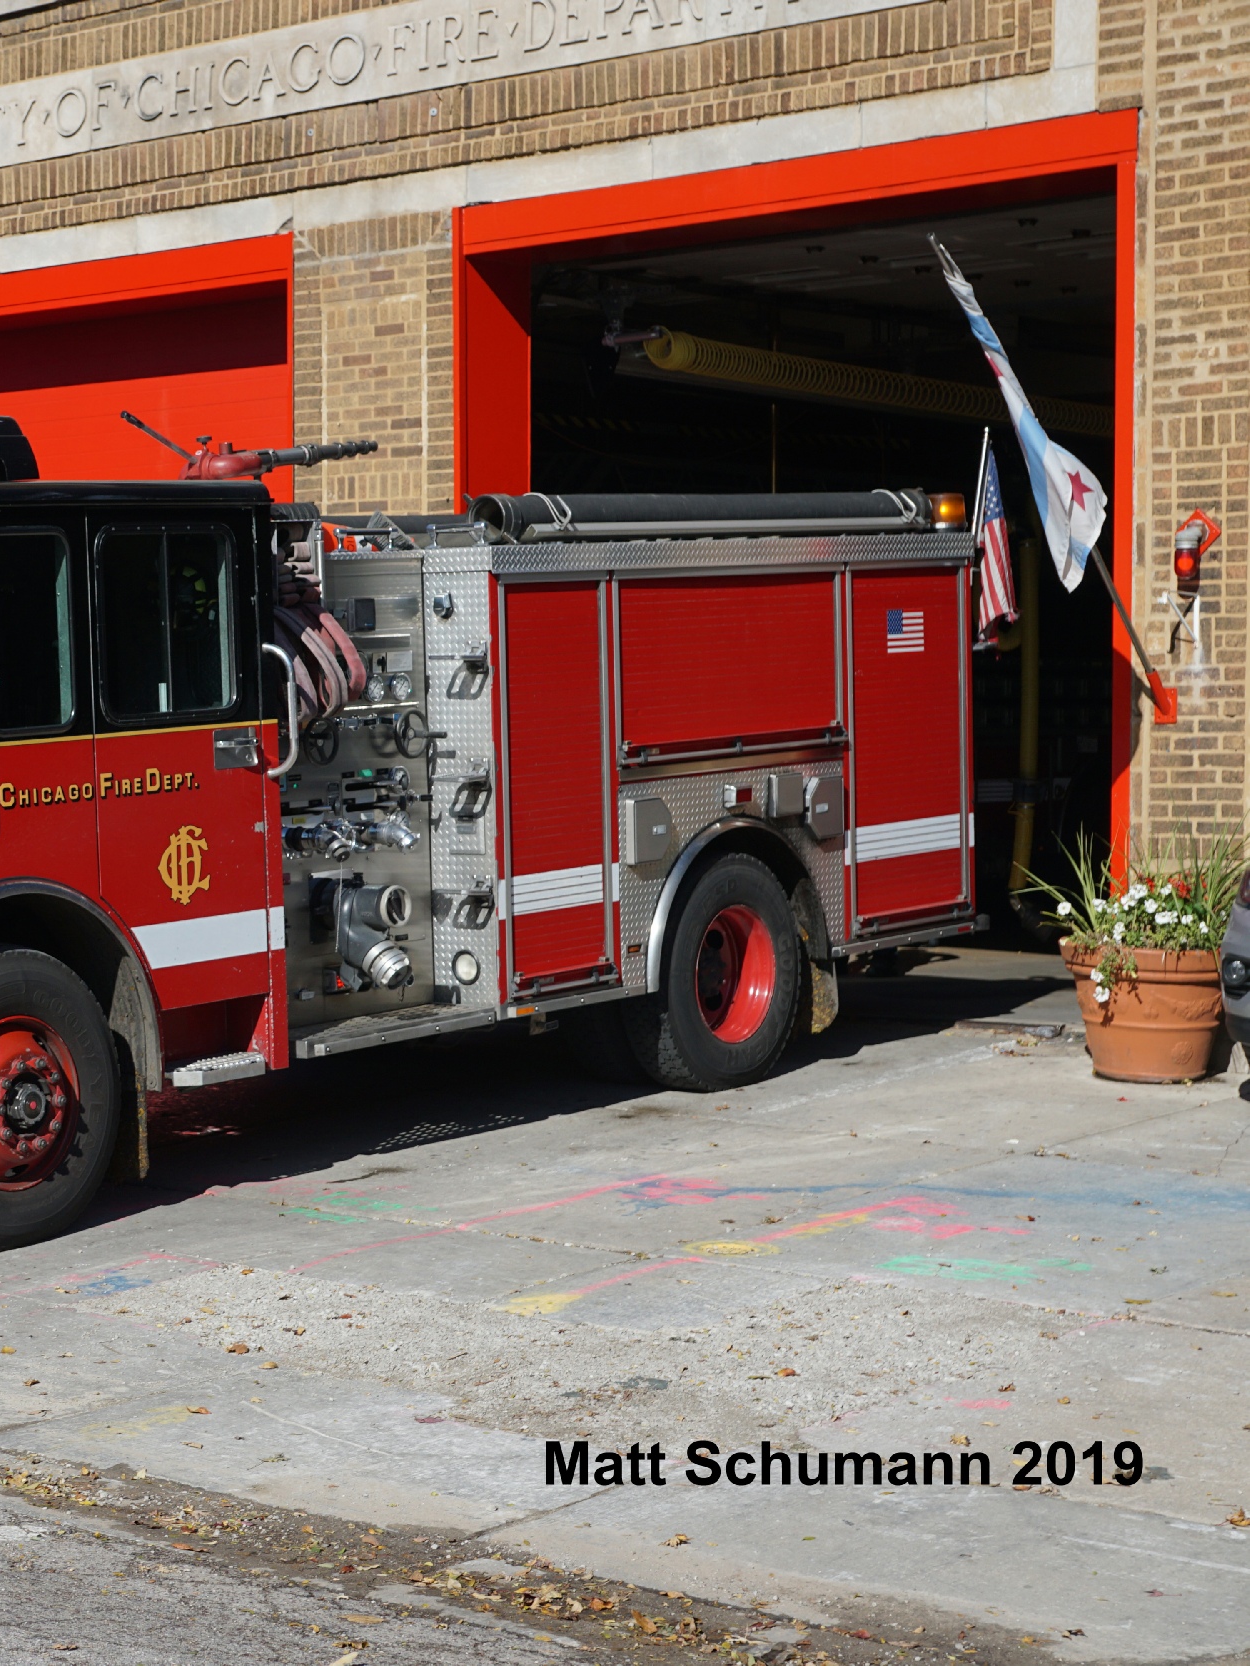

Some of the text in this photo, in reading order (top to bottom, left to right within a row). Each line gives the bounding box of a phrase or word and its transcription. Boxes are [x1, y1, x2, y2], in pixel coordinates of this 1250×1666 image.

[55, 81, 117, 138] OF
[134, 33, 366, 122] CHICAGO
[386, 7, 500, 77] FIRE
[0, 767, 200, 809] CHICAGO FIRE DEPT.
